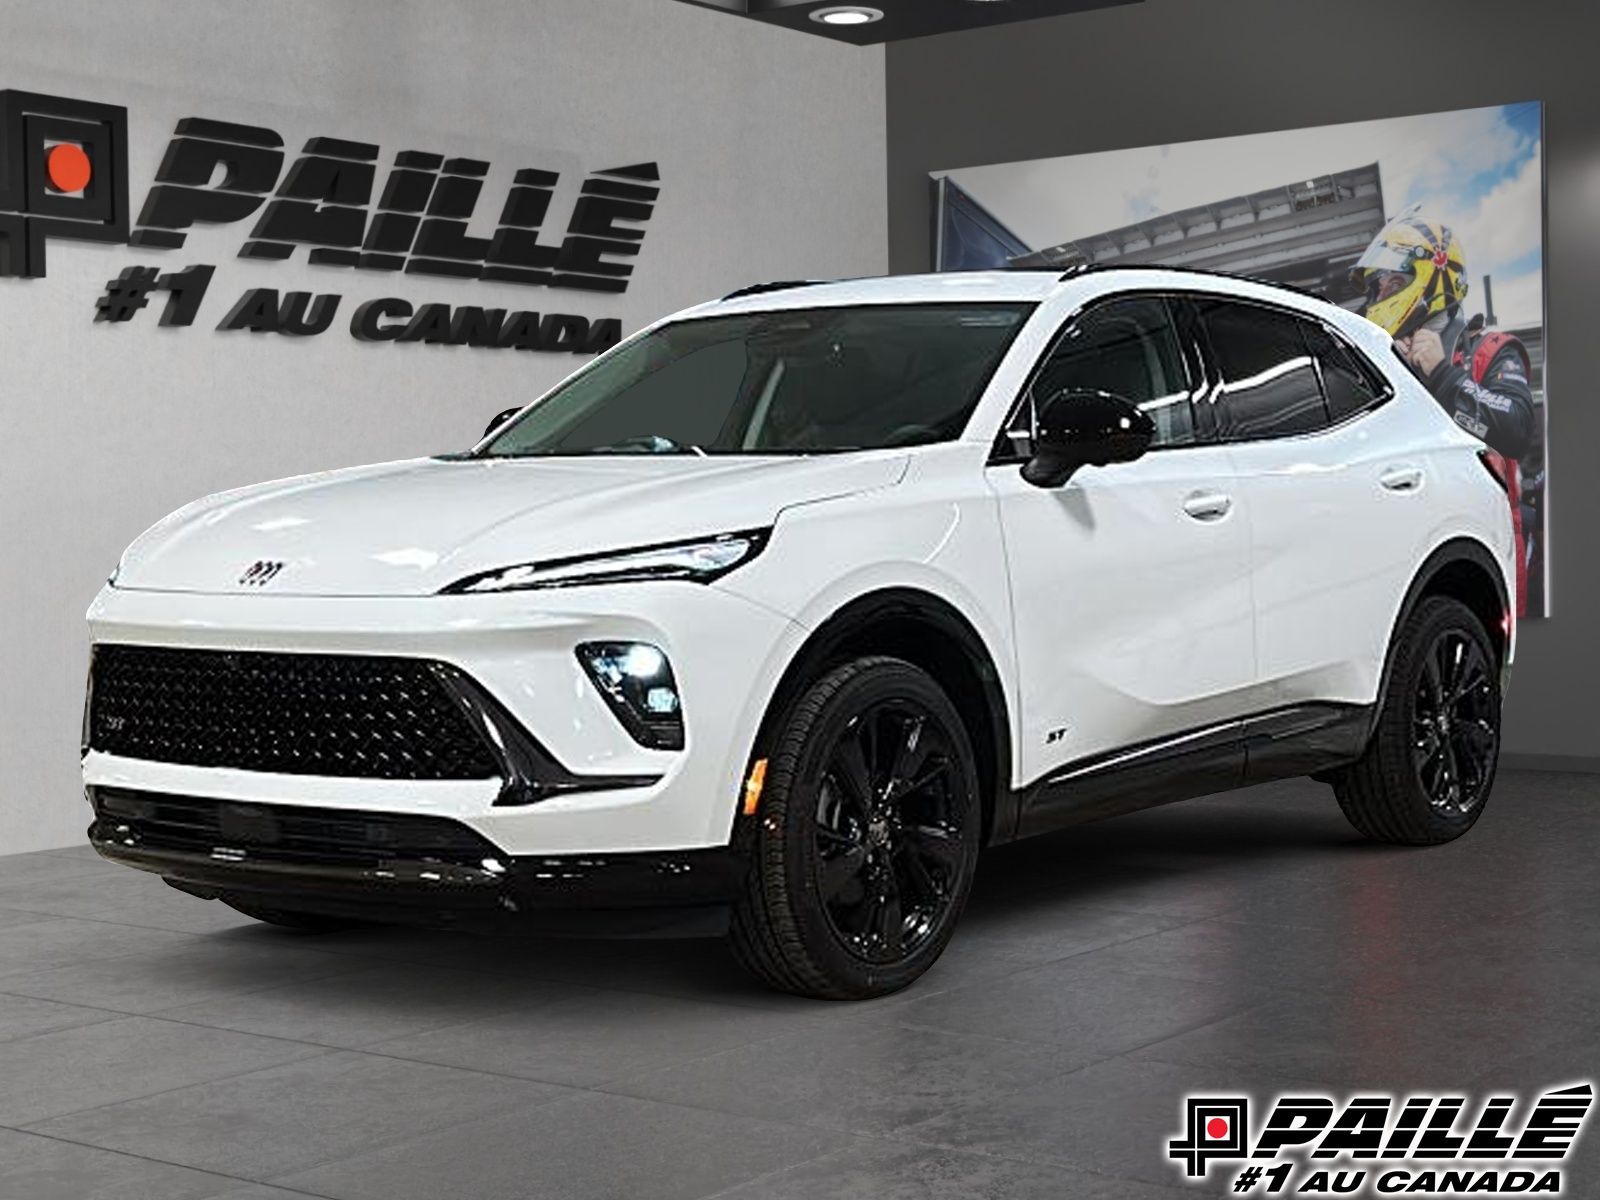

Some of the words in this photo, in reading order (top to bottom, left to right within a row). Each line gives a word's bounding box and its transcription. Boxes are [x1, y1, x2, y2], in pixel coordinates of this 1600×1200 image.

[128, 117, 661, 293] PAILLÉ
[95, 265, 216, 327] #1
[215, 288, 342, 335] AU
[350, 298, 622, 354] CANADA
